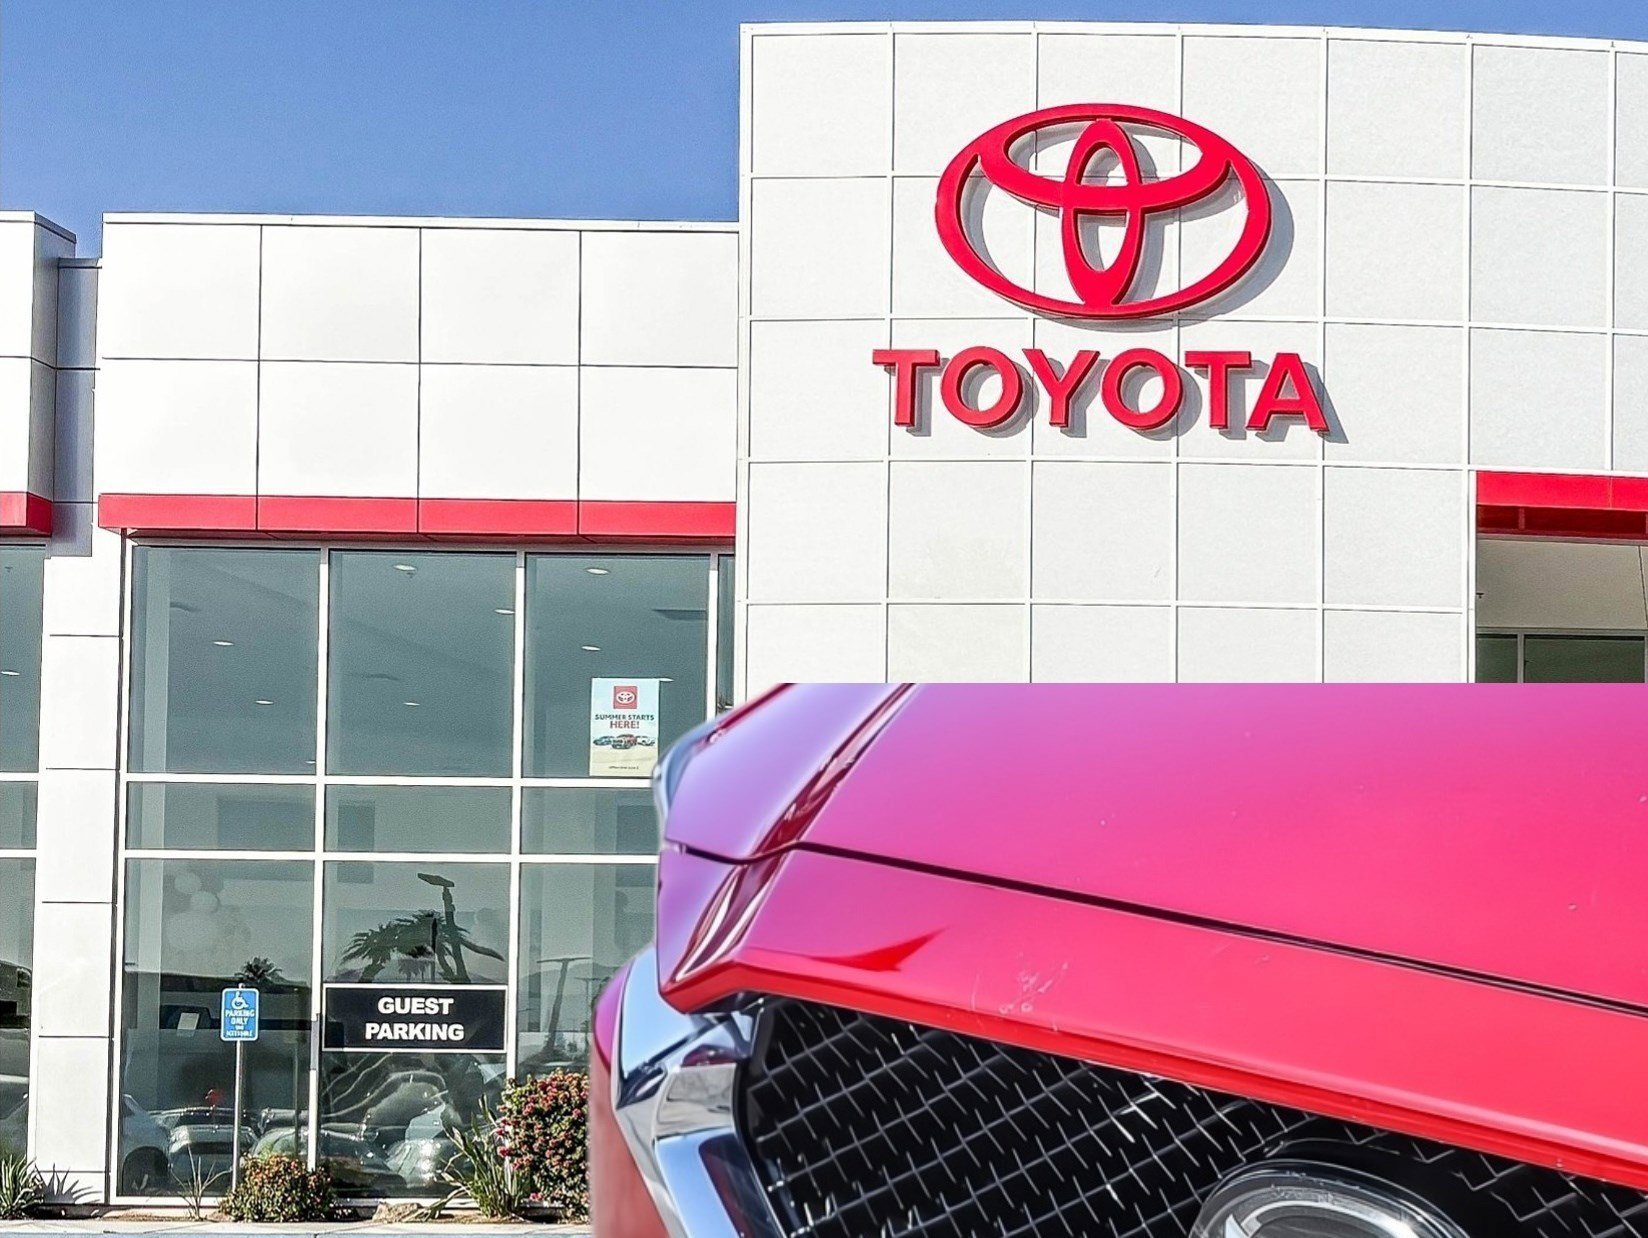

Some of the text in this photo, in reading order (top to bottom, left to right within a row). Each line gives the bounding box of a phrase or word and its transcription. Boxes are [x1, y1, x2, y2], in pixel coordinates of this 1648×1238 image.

[872, 346, 1329, 433] TOYOTA
[609, 720, 640, 729] HERE!
[377, 996, 454, 1015] GUEST
[225, 1009, 255, 1017] PARKING
[230, 1017, 249, 1025] ONLY
[365, 1022, 465, 1041] PARKING
